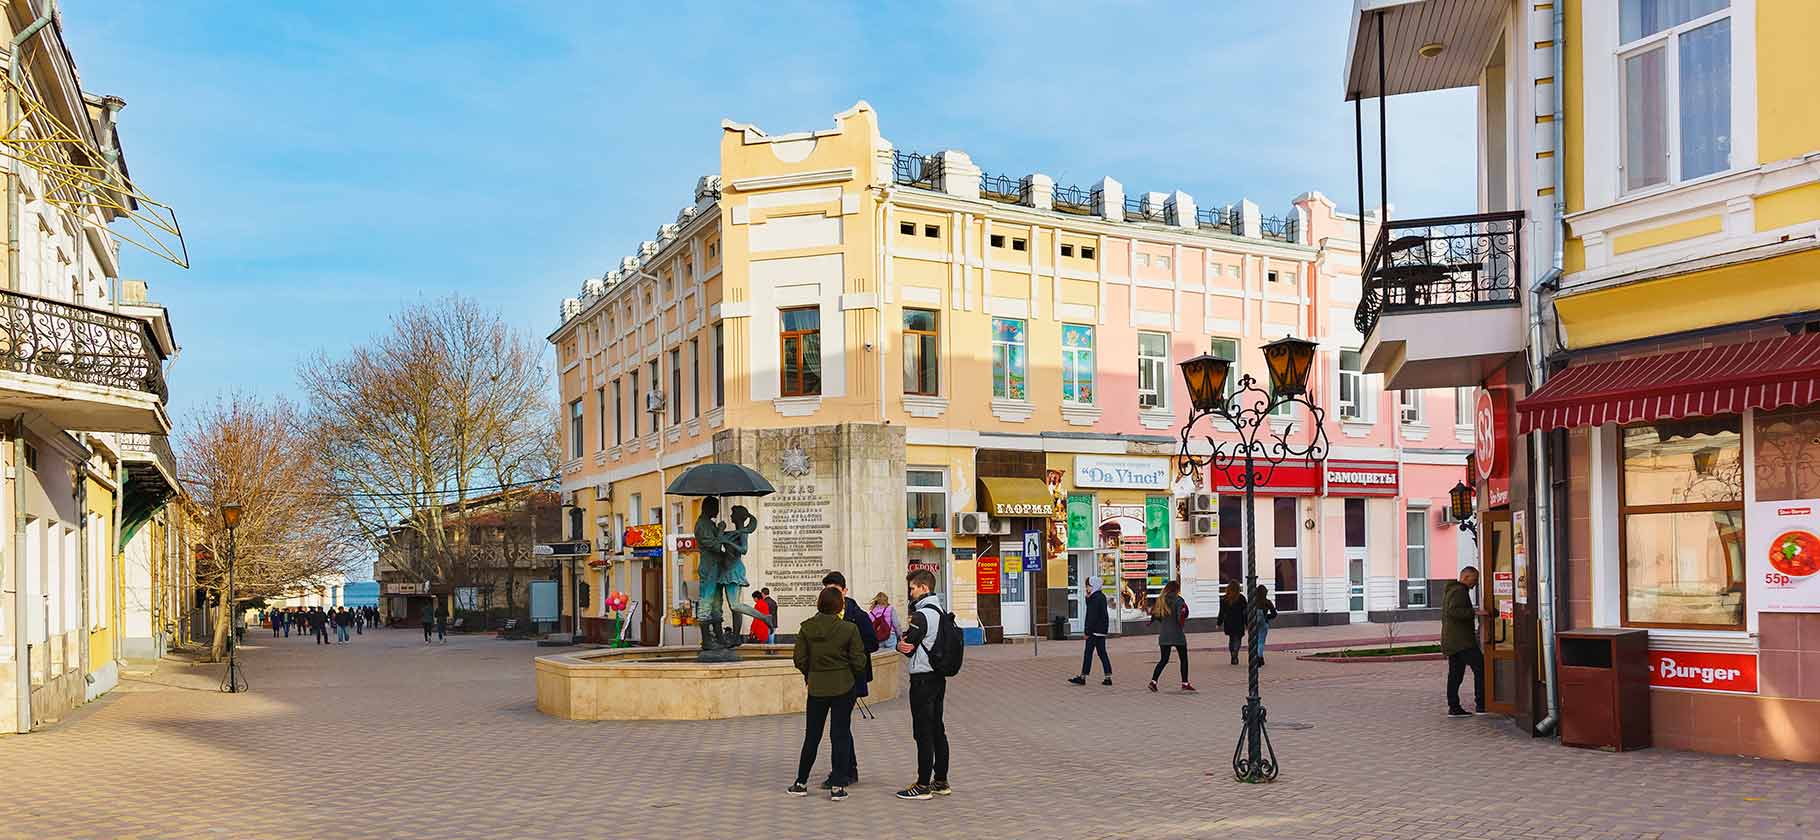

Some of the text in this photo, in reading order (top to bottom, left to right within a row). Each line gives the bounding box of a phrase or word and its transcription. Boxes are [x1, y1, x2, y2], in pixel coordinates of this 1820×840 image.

[1328, 471, 1396, 485] САМОЦВЕТЫ
[996, 503, 1053, 515] ГЛОРИЯ
[1660, 657, 1741, 684] Burger
